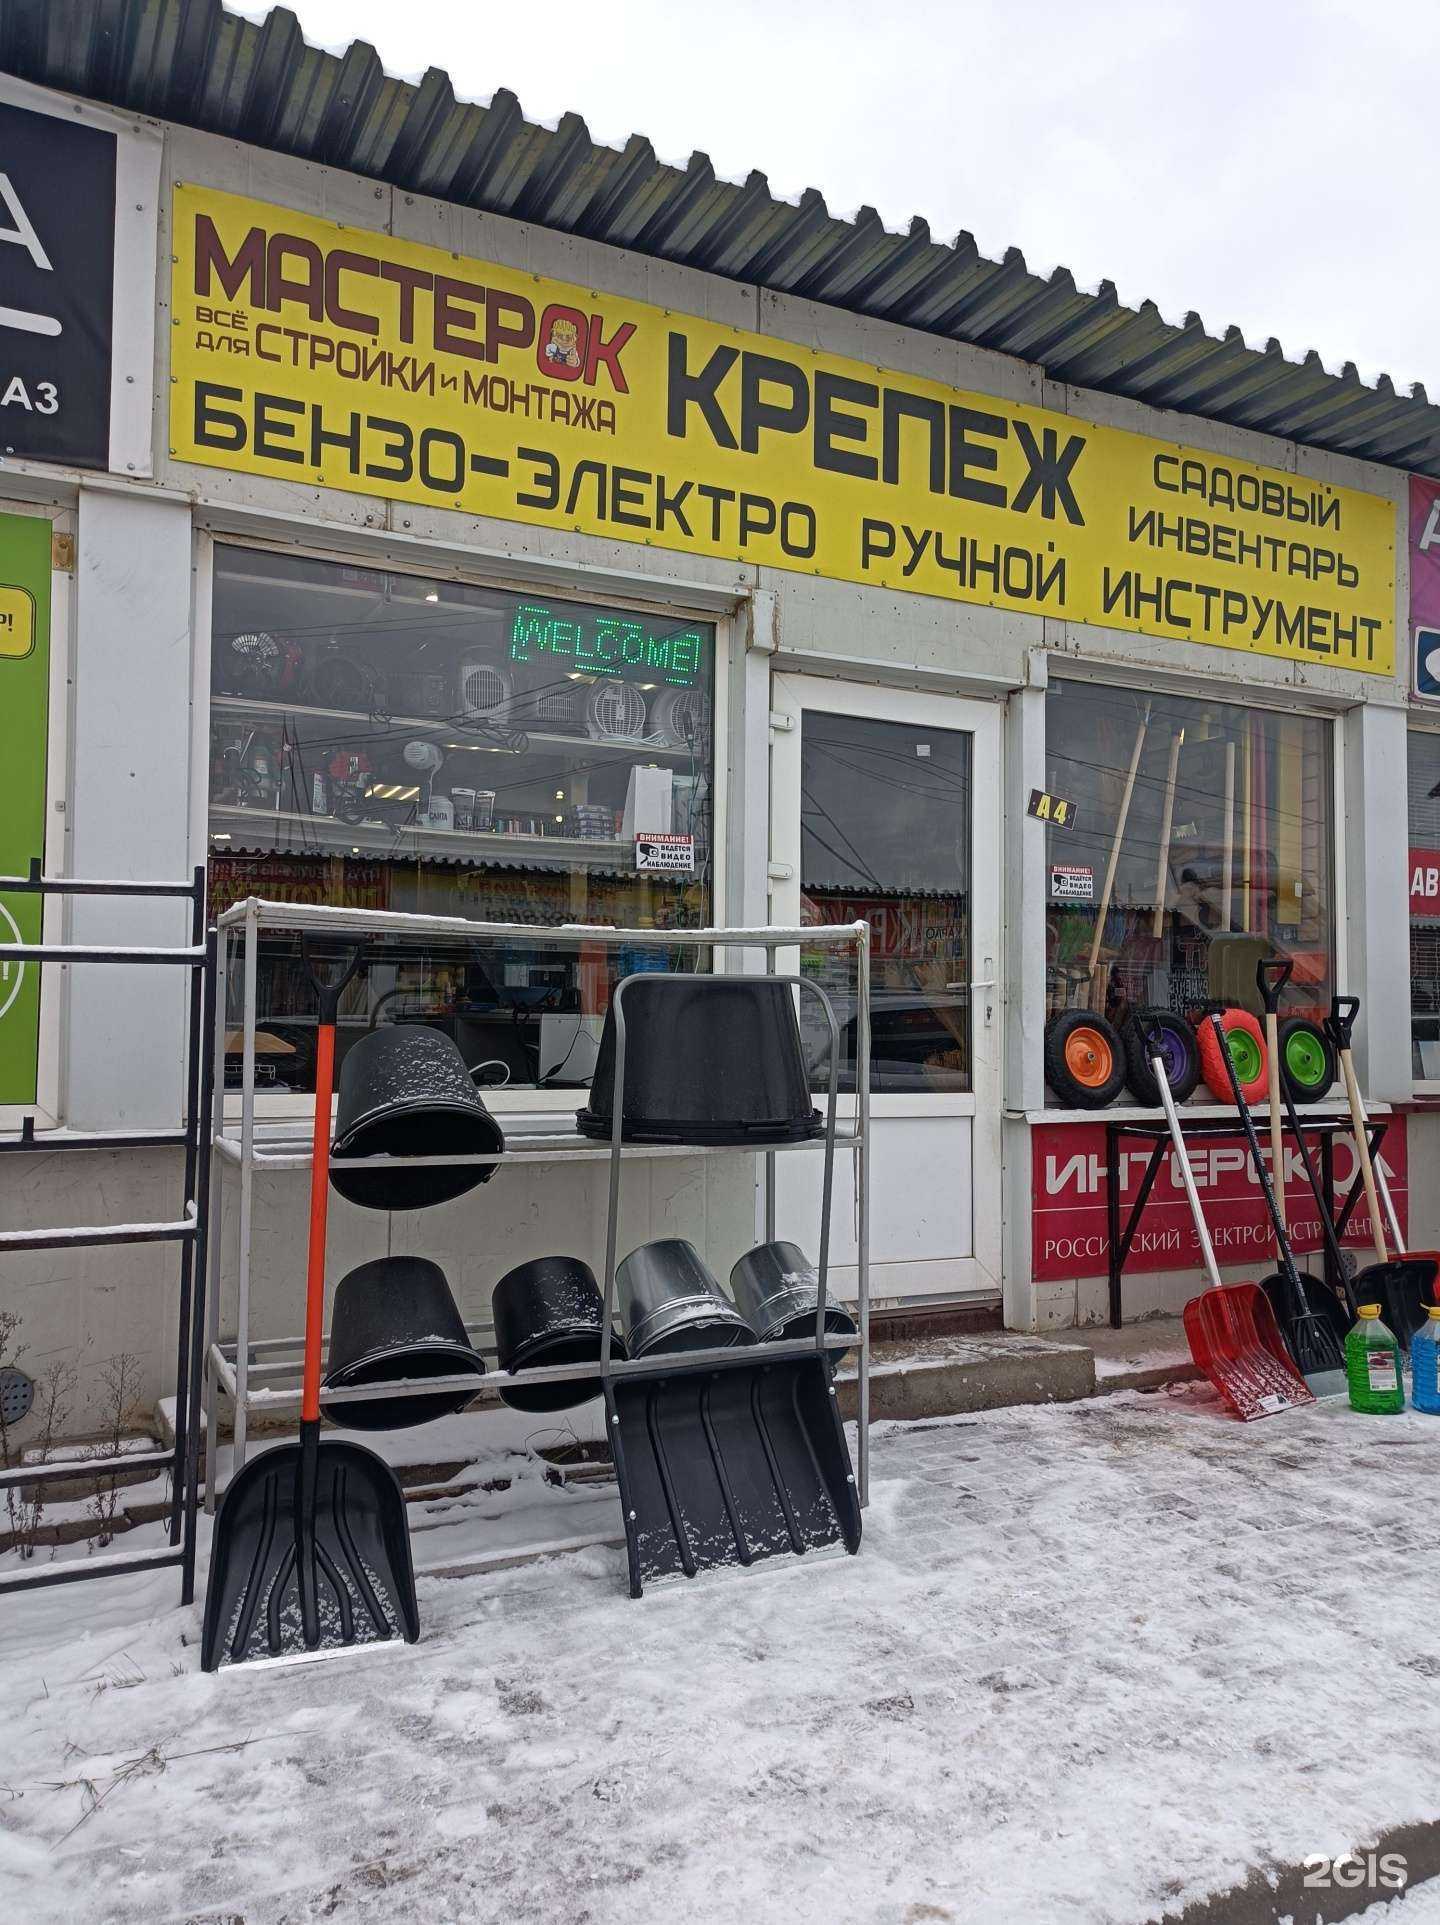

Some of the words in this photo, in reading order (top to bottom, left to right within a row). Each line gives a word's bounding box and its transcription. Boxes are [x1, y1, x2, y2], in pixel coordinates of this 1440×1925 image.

[195, 213, 638, 395] МАСТЕРОК
[196, 305, 249, 331] ВСЁ
[196, 331, 250, 356] ДЛЯ
[255, 322, 435, 397] СТРОЙКИ
[463, 369, 616, 436] МОНТАЖА
[667, 331, 1087, 527] КРЕПЕЖ
[194, 380, 817, 559] БЕНЗО-ЭЛЕКТРО
[861, 517, 1067, 606] РУЧНОЙ
[1103, 566, 1382, 661] ИНСТРУМЕНТ
[1153, 453, 1341, 531] САДОВЫЙ
[1128, 505, 1360, 588] ИНВЕНТАРЬ
[514, 616, 691, 673] WELCOME
[660, 853, 690, 861] ВИДЕО
[1045, 1228, 1181, 1260] РОССИСКИЙ
